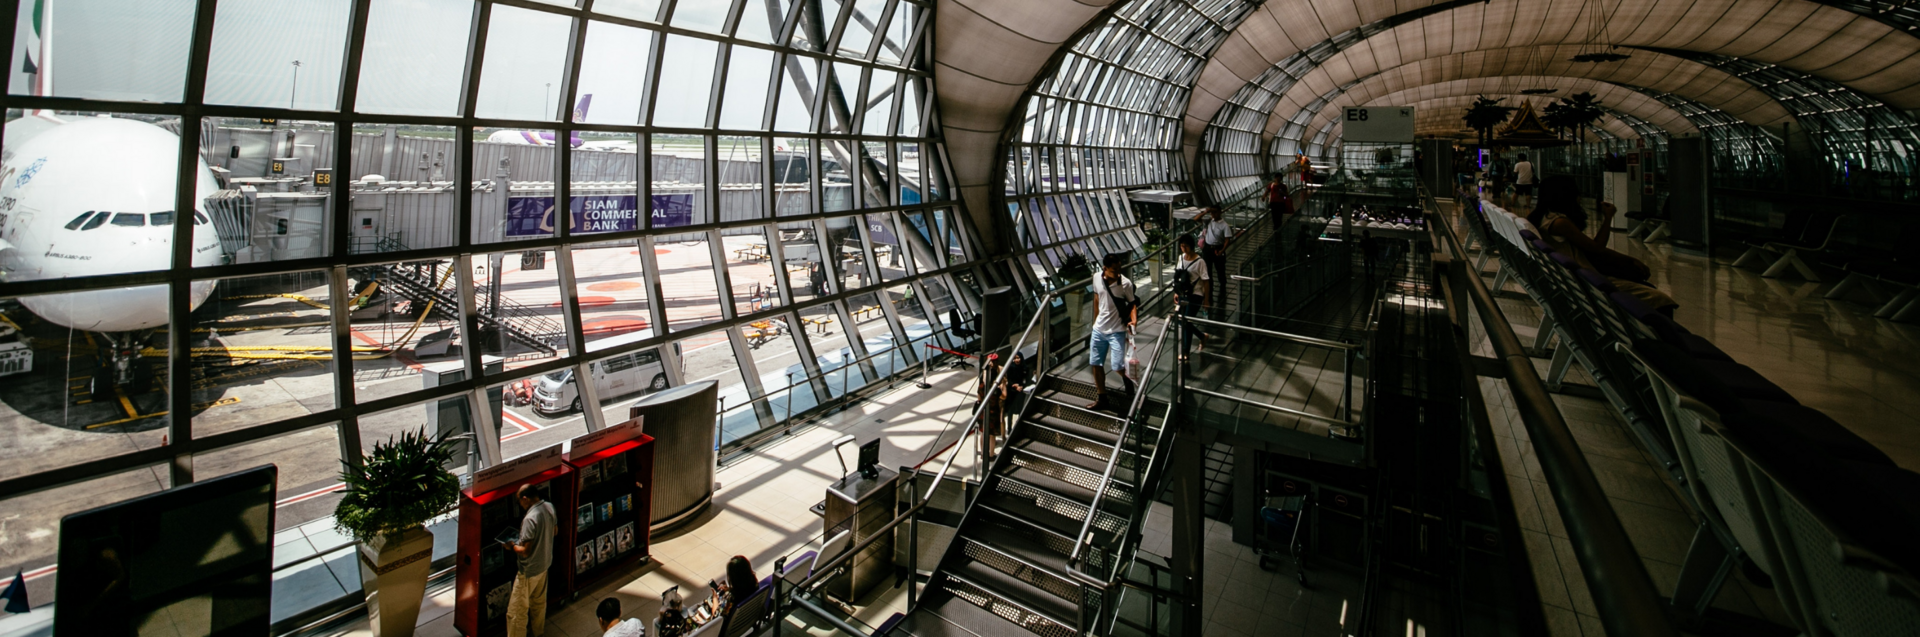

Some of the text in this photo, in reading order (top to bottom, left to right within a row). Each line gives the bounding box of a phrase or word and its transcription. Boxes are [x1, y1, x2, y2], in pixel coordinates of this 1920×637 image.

[1347, 108, 1368, 121] E8
[273, 163, 283, 171] E8
[316, 174, 331, 184] E8
[584, 200, 618, 209] SIAM
[583, 209, 667, 220] COMMERAL
[583, 221, 619, 231] BANK
[871, 224, 882, 232] SCB
[477, 465, 508, 478] Newspapers
[507, 460, 517, 469] and
[517, 453, 542, 465] Magazines
